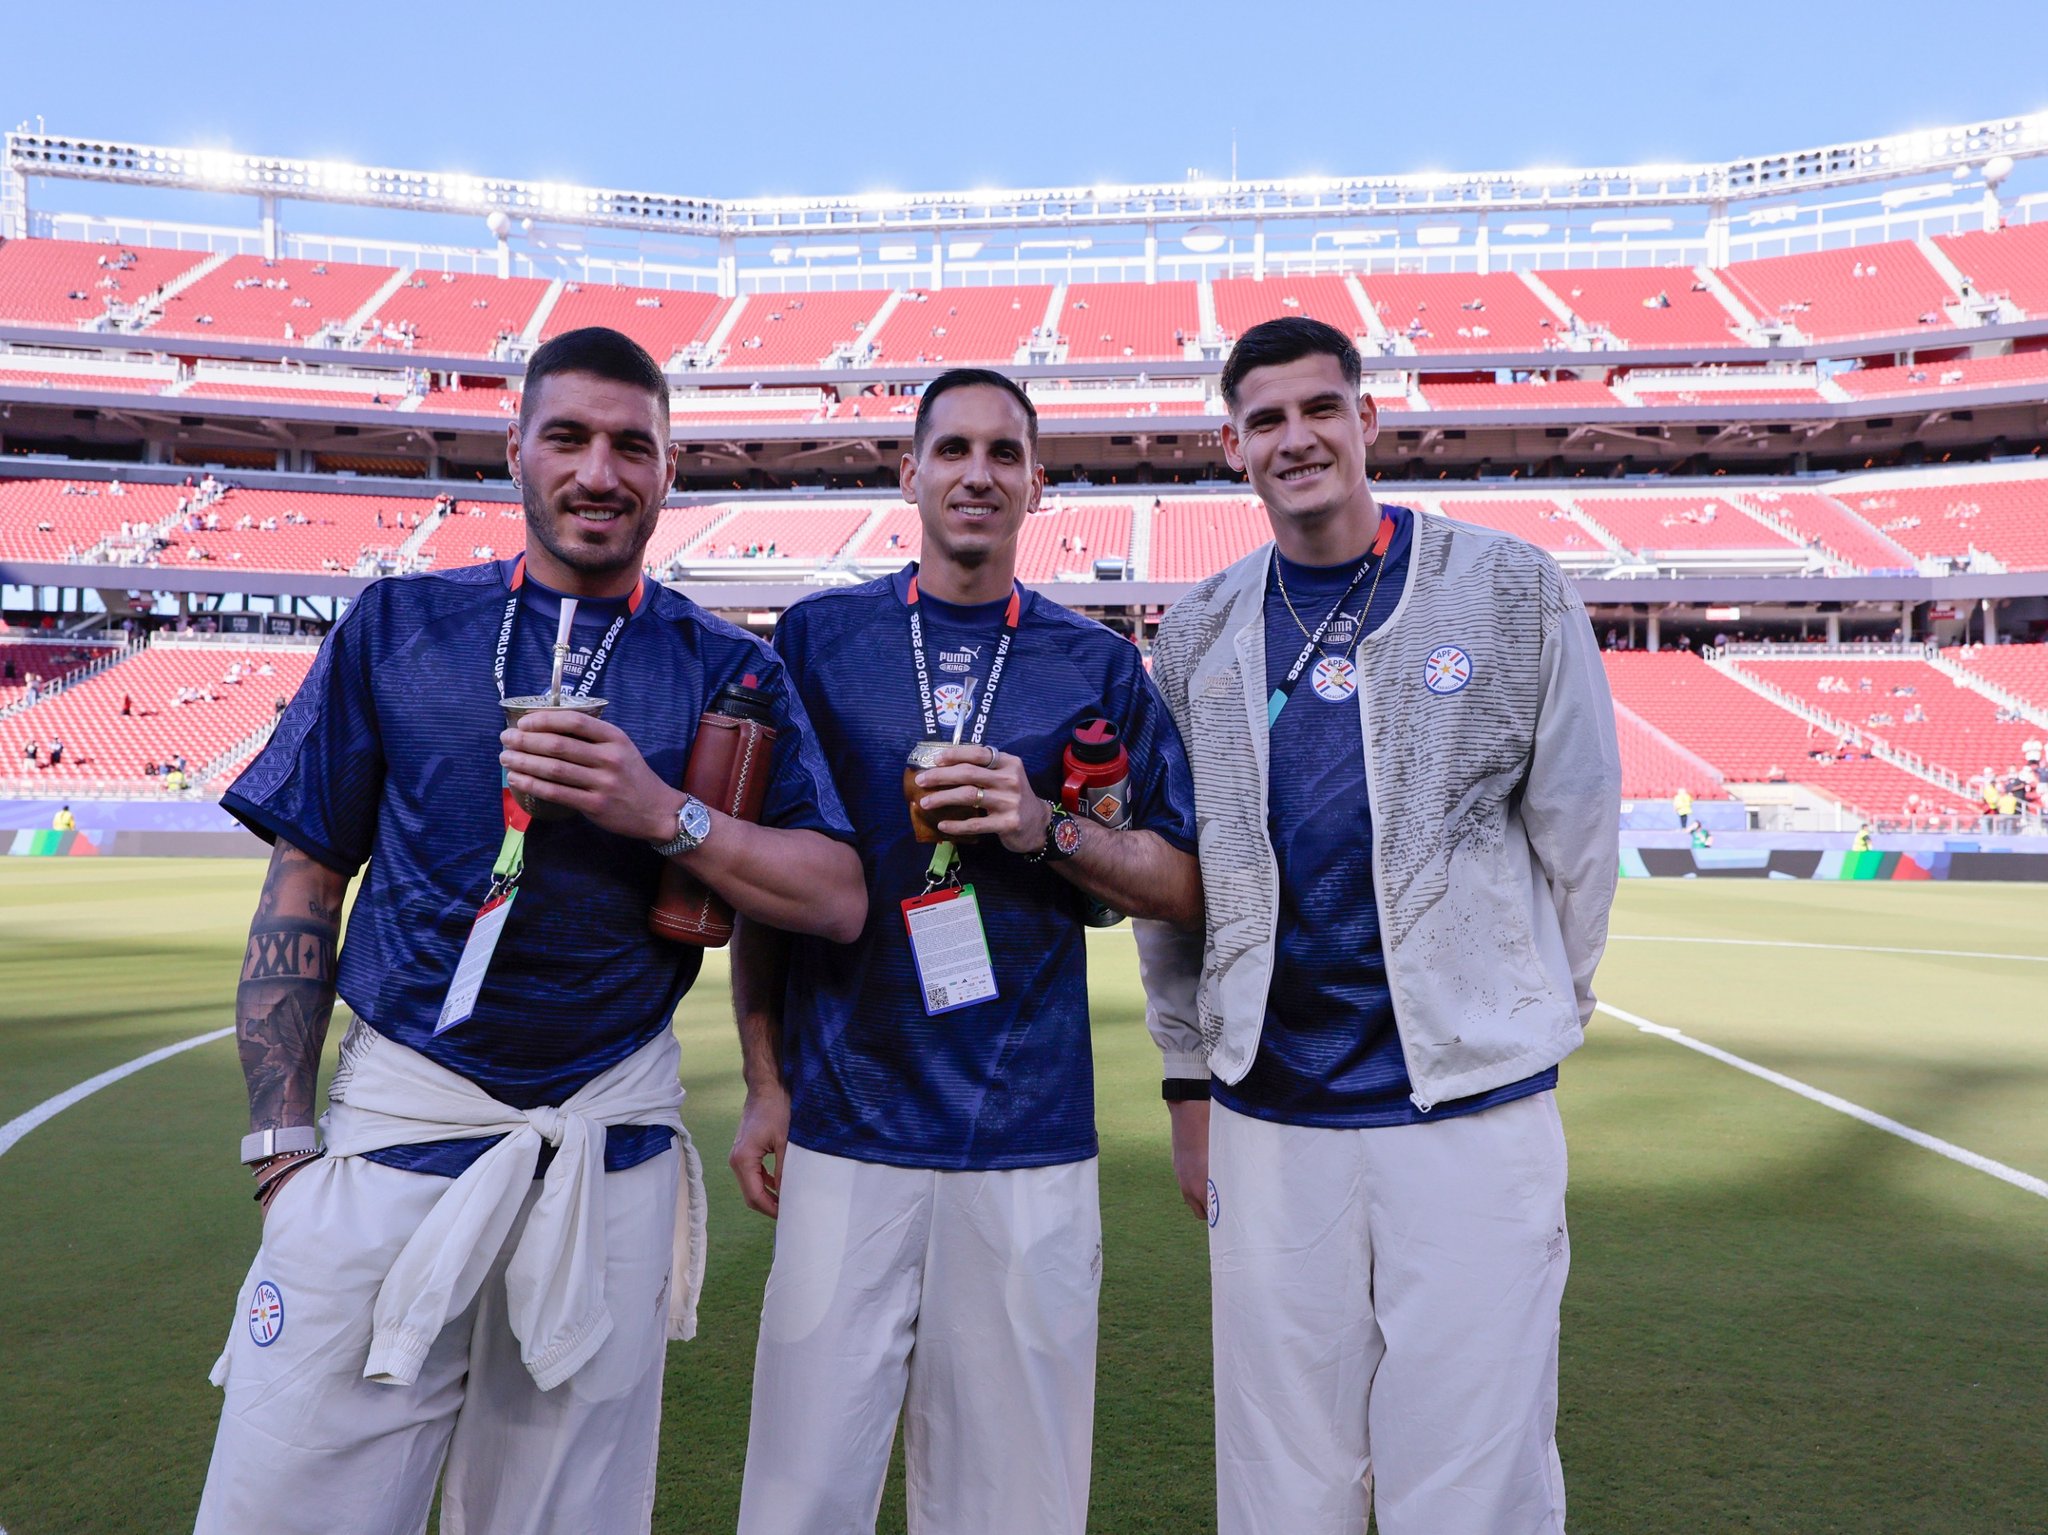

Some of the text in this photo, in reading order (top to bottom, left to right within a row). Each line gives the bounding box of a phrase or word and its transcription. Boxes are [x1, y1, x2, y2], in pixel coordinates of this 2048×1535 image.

[1352, 561, 1370, 584] FIFA
[504, 598, 517, 620] FIFA
[496, 619, 512, 655] WORLD
[1327, 620, 1352, 632] UMA
[1327, 633, 1345, 642] KING
[576, 616, 625, 698] ORLD CUP 2026
[939, 652, 971, 663] PUMA
[1288, 621, 1328, 680] CUP 2026
[1437, 649, 1452, 659] APF
[494, 656, 506, 679] CUP
[910, 613, 937, 734] FIFA WORLD CUP 2026
[946, 663, 964, 671] KING
[944, 687, 959, 695] APF
[971, 634, 1011, 744] FIFA WORLD CUP 202
[263, 1288, 276, 1302] APF
